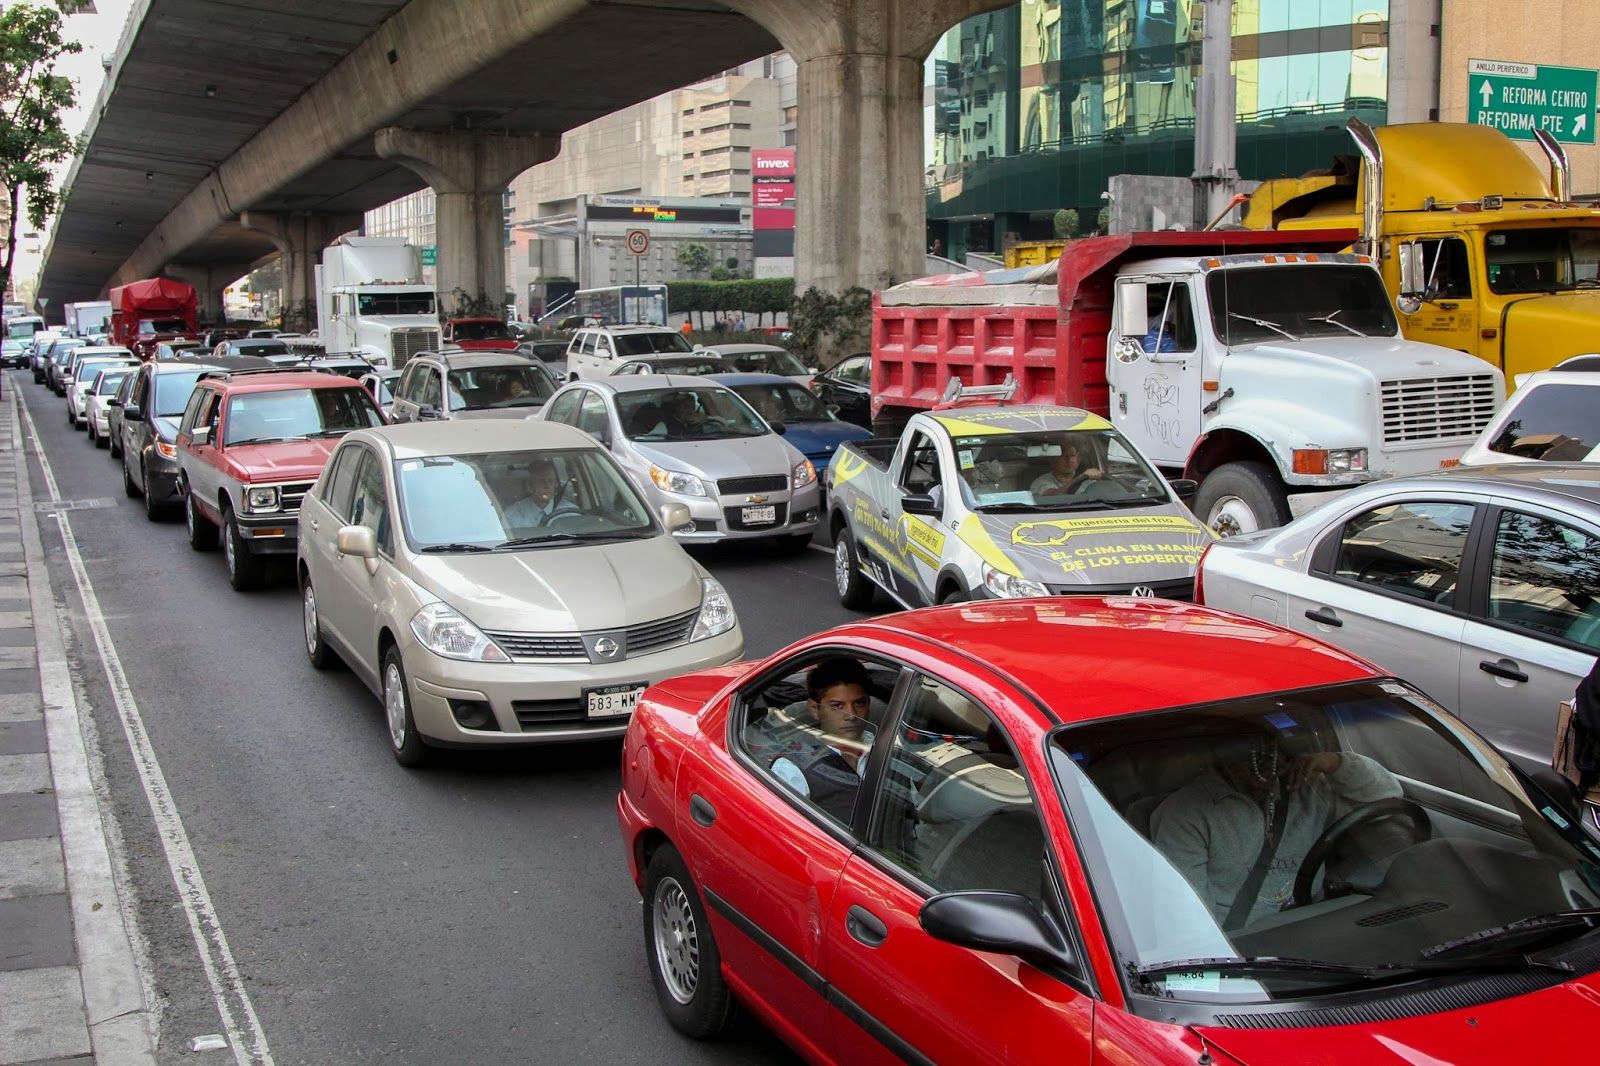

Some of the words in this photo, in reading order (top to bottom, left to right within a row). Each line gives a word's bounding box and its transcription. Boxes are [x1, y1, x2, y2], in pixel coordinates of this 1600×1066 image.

[1476, 63, 1496, 71] ANILLO
[1497, 64, 1529, 74] PERIFERICO
[1502, 86, 1547, 106] REFORMA
[1551, 89, 1588, 109] CENTRO
[1478, 110, 1535, 130] REFORMA
[1541, 115, 1563, 132] PTE
[757, 157, 790, 168] invex
[632, 234, 644, 246] 60
[1050, 551, 1073, 561] EL
[1074, 545, 1128, 556] CLIMA
[1129, 544, 1154, 552] EN
[1061, 559, 1087, 573] DE
[1088, 556, 1120, 568] LOS
[1122, 554, 1201, 565] EXPERTO
